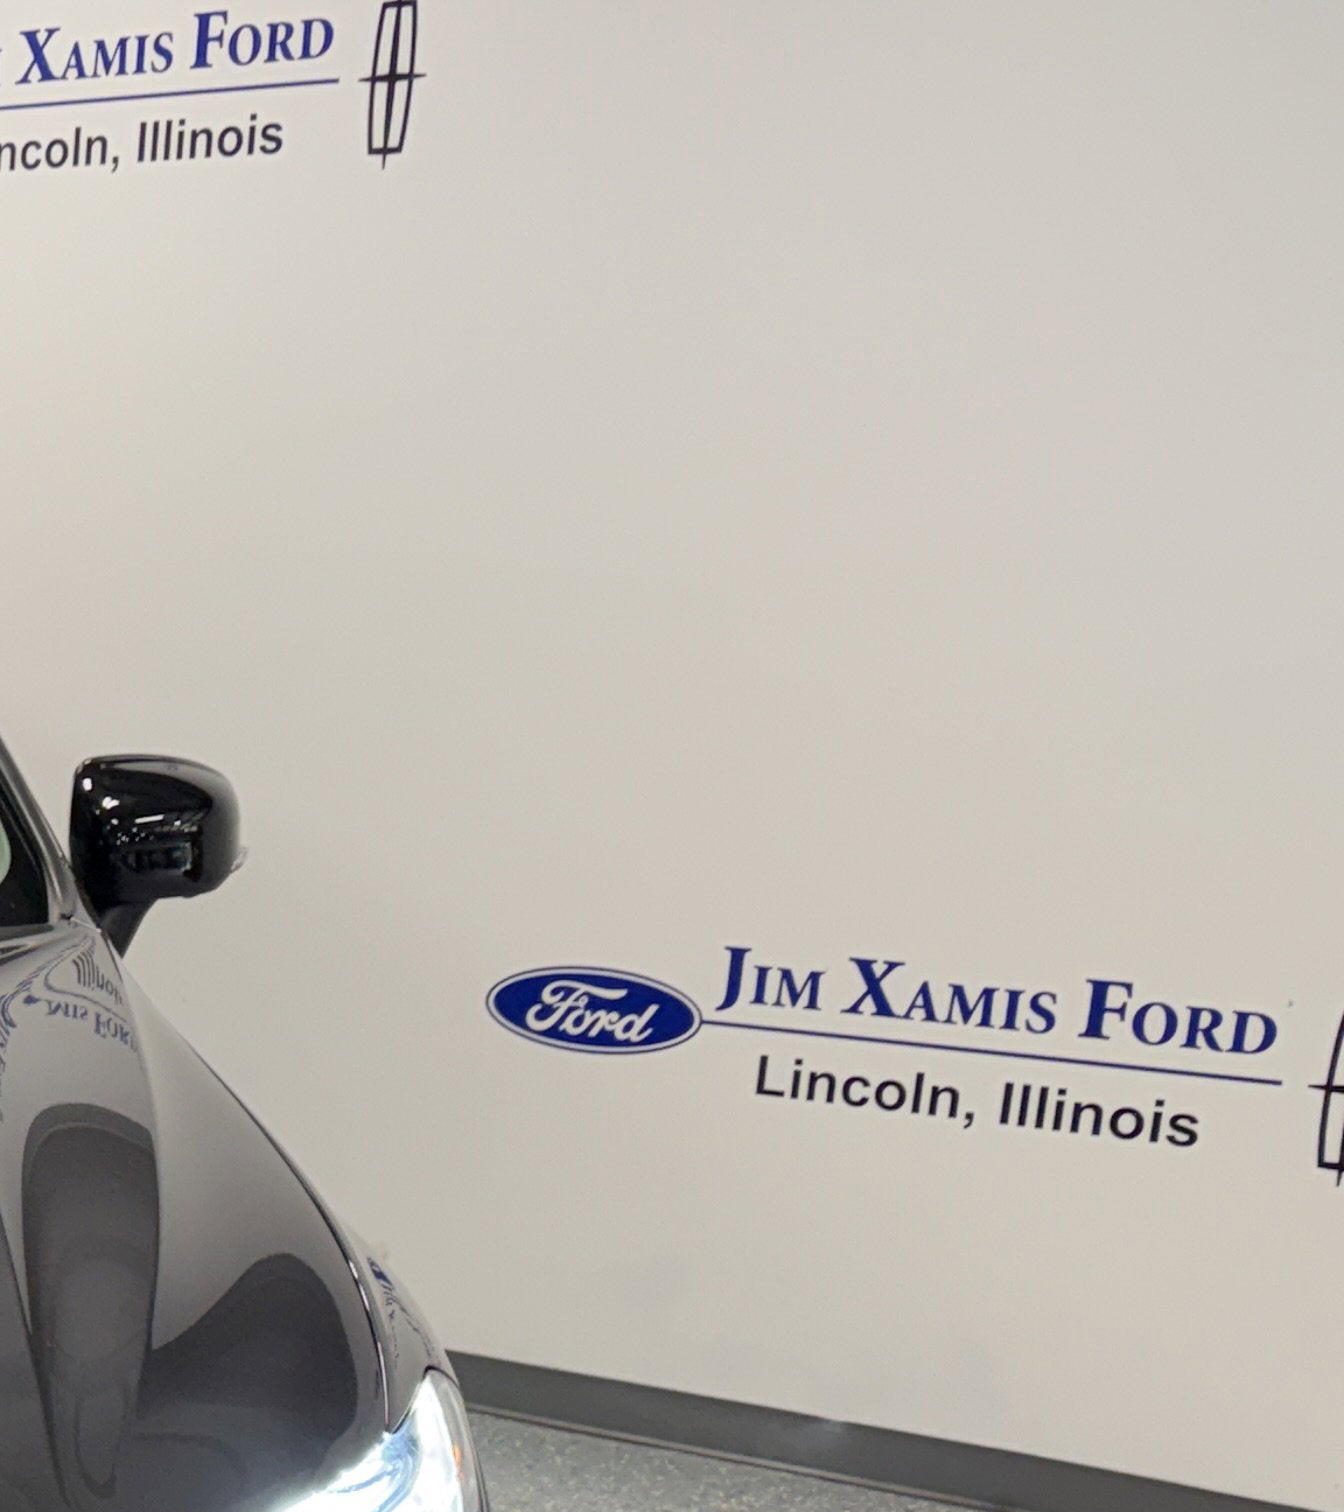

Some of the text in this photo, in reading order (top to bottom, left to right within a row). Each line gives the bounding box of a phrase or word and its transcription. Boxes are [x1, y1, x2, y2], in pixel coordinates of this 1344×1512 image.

[14, 27, 174, 86] XAMIS
[189, 10, 336, 70] FORD
[137, 113, 284, 165] Illinois
[524, 979, 655, 1043] Ford
[714, 945, 1280, 1057] JIM XAMIS FORD
[754, 1054, 1201, 1149] Lincoln, Illinois
